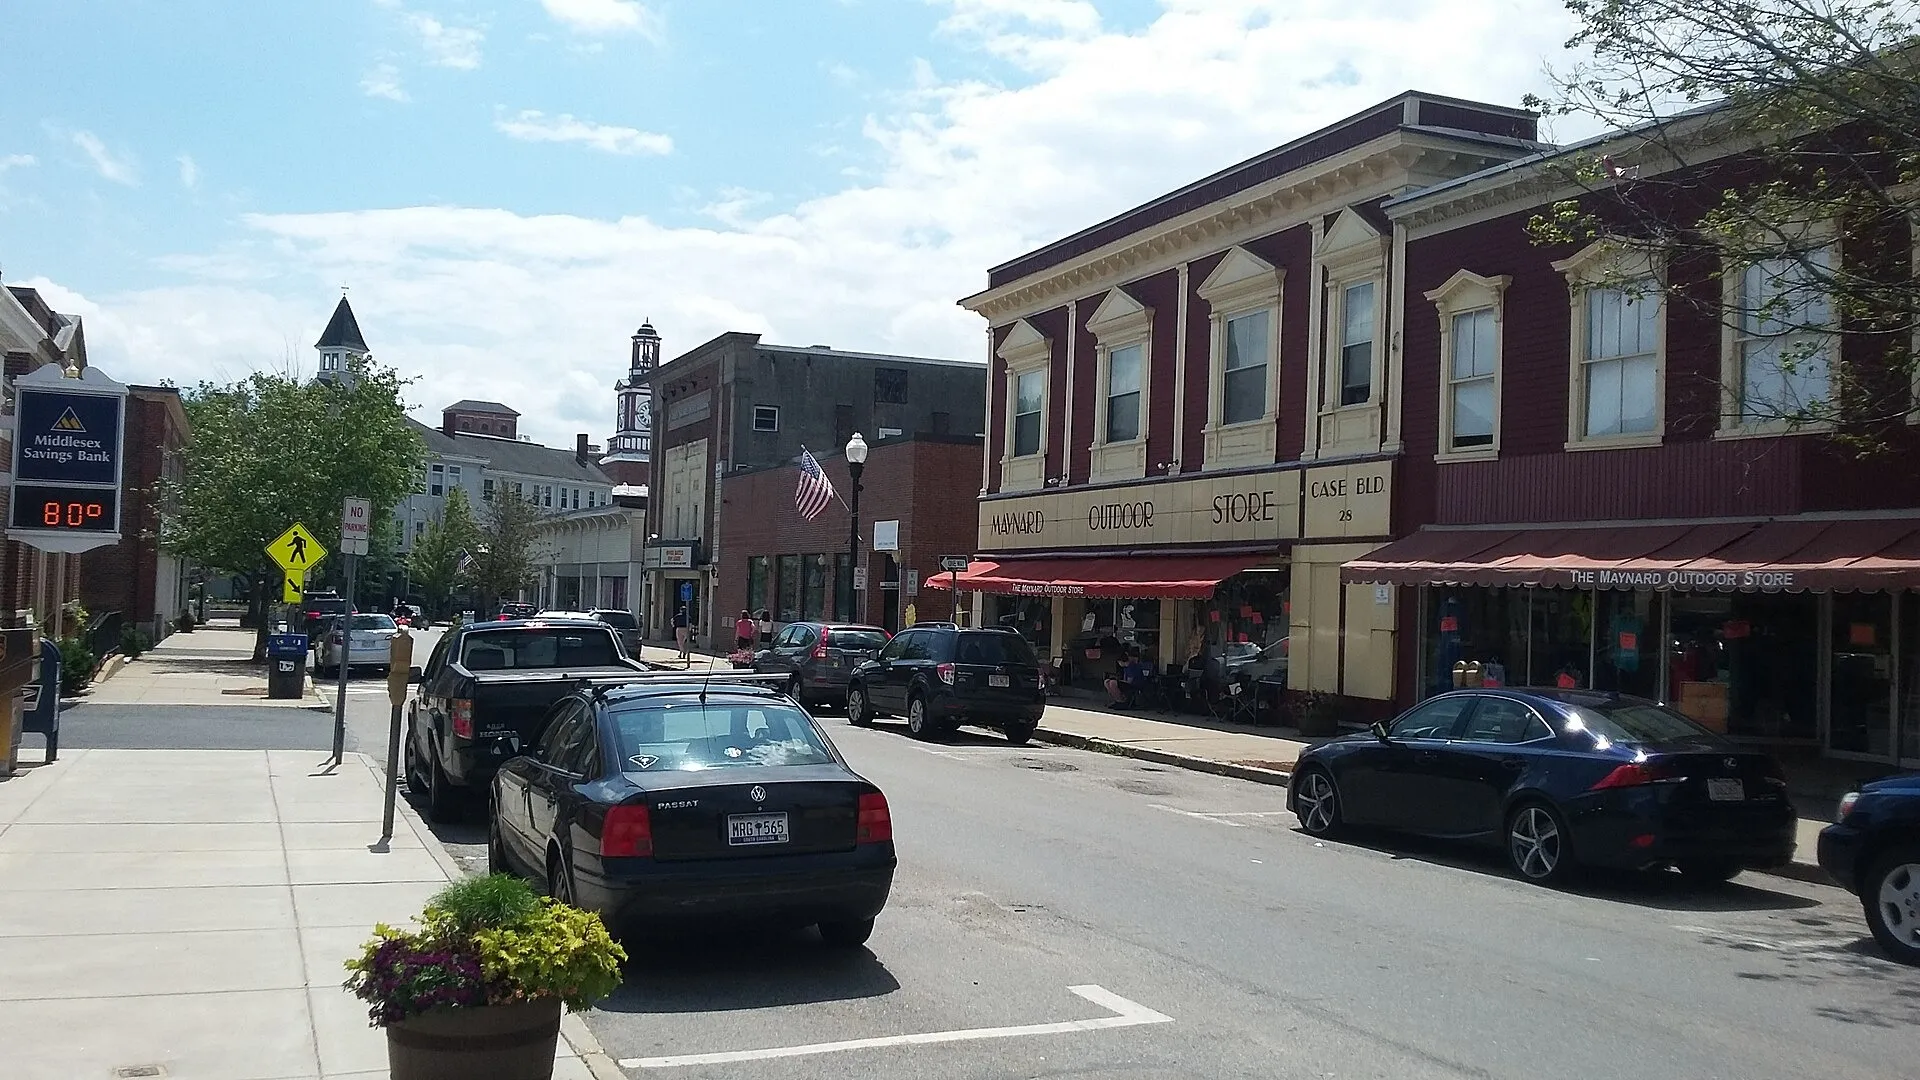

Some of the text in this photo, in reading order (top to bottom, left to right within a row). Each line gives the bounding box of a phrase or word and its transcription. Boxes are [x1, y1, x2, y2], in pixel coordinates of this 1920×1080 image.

[34, 434, 101, 448] Middlesex
[24, 447, 110, 463] Savings Bank
[1311, 476, 1386, 499] CASE BLD.
[350, 506, 364, 518] NO
[990, 490, 1275, 536] MAYNARD OUTDOOR STORE
[1338, 509, 1353, 522] 28
[344, 522, 368, 532] PARKING
[1569, 569, 1794, 586] THE MAYNARD OUTDOOR STORE
[1012, 583, 1084, 594] THE MAYNARD OUTDOOR STORE
[657, 799, 699, 810] PASSAT
[732, 820, 784, 837] MRG 565
